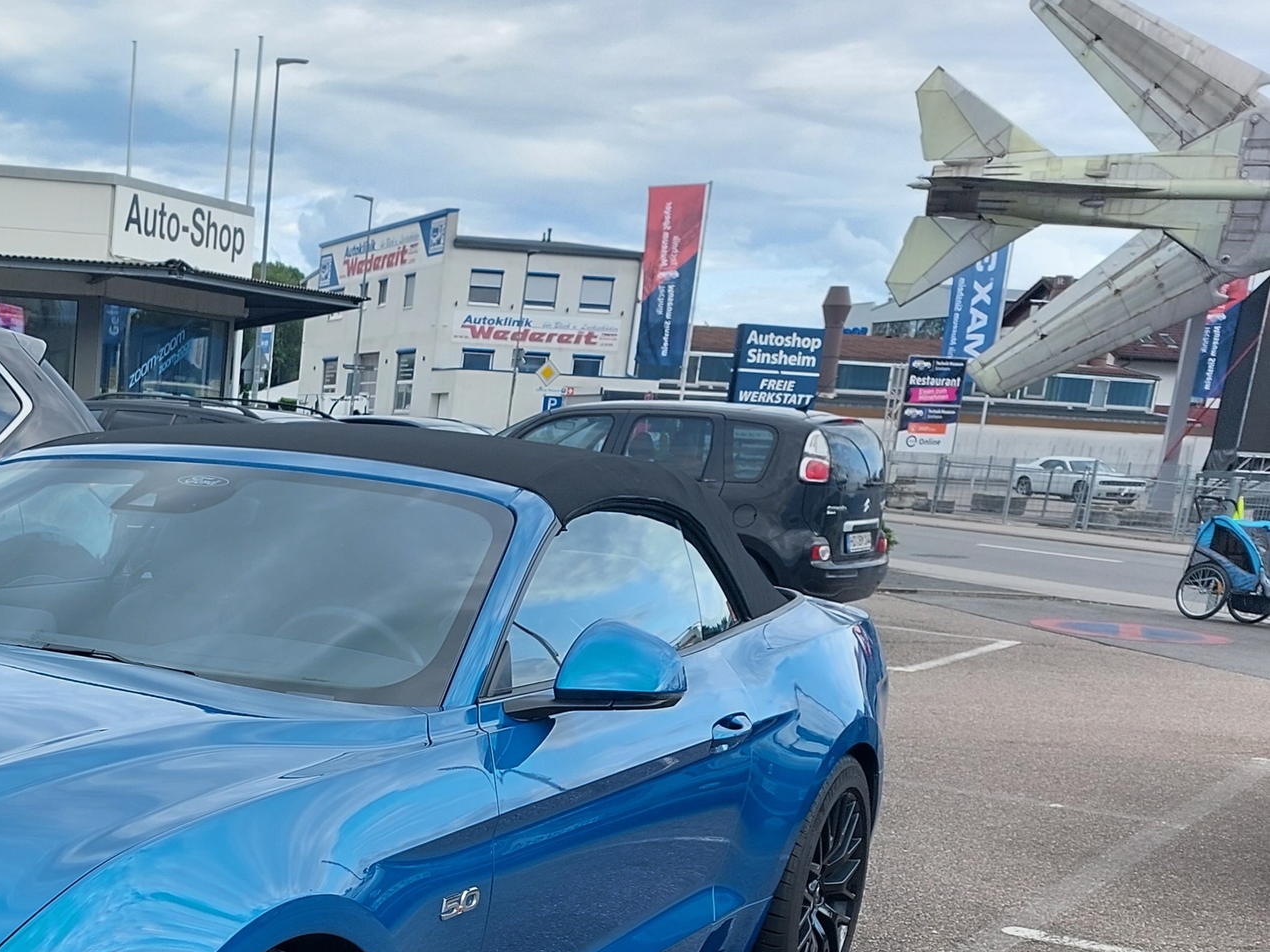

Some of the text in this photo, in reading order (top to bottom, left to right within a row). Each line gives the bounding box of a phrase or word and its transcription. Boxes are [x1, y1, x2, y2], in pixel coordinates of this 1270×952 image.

[125, 193, 245, 263] Auto-Shop
[343, 244, 409, 277] Wedereit
[463, 314, 533, 328] Autoklinik
[461, 324, 598, 346] Wedereit
[746, 329, 822, 353] Autoshop
[129, 329, 187, 389] zoom-zoom
[746, 348, 817, 368] Sinsheim
[759, 378, 796, 392] FREIE
[909, 375, 961, 387] Restaurant
[547, 397, 558, 410] P
[738, 390, 815, 405] WERKSTATT
[919, 438, 941, 446] Online
[440, 886, 480, 920] 5.0
